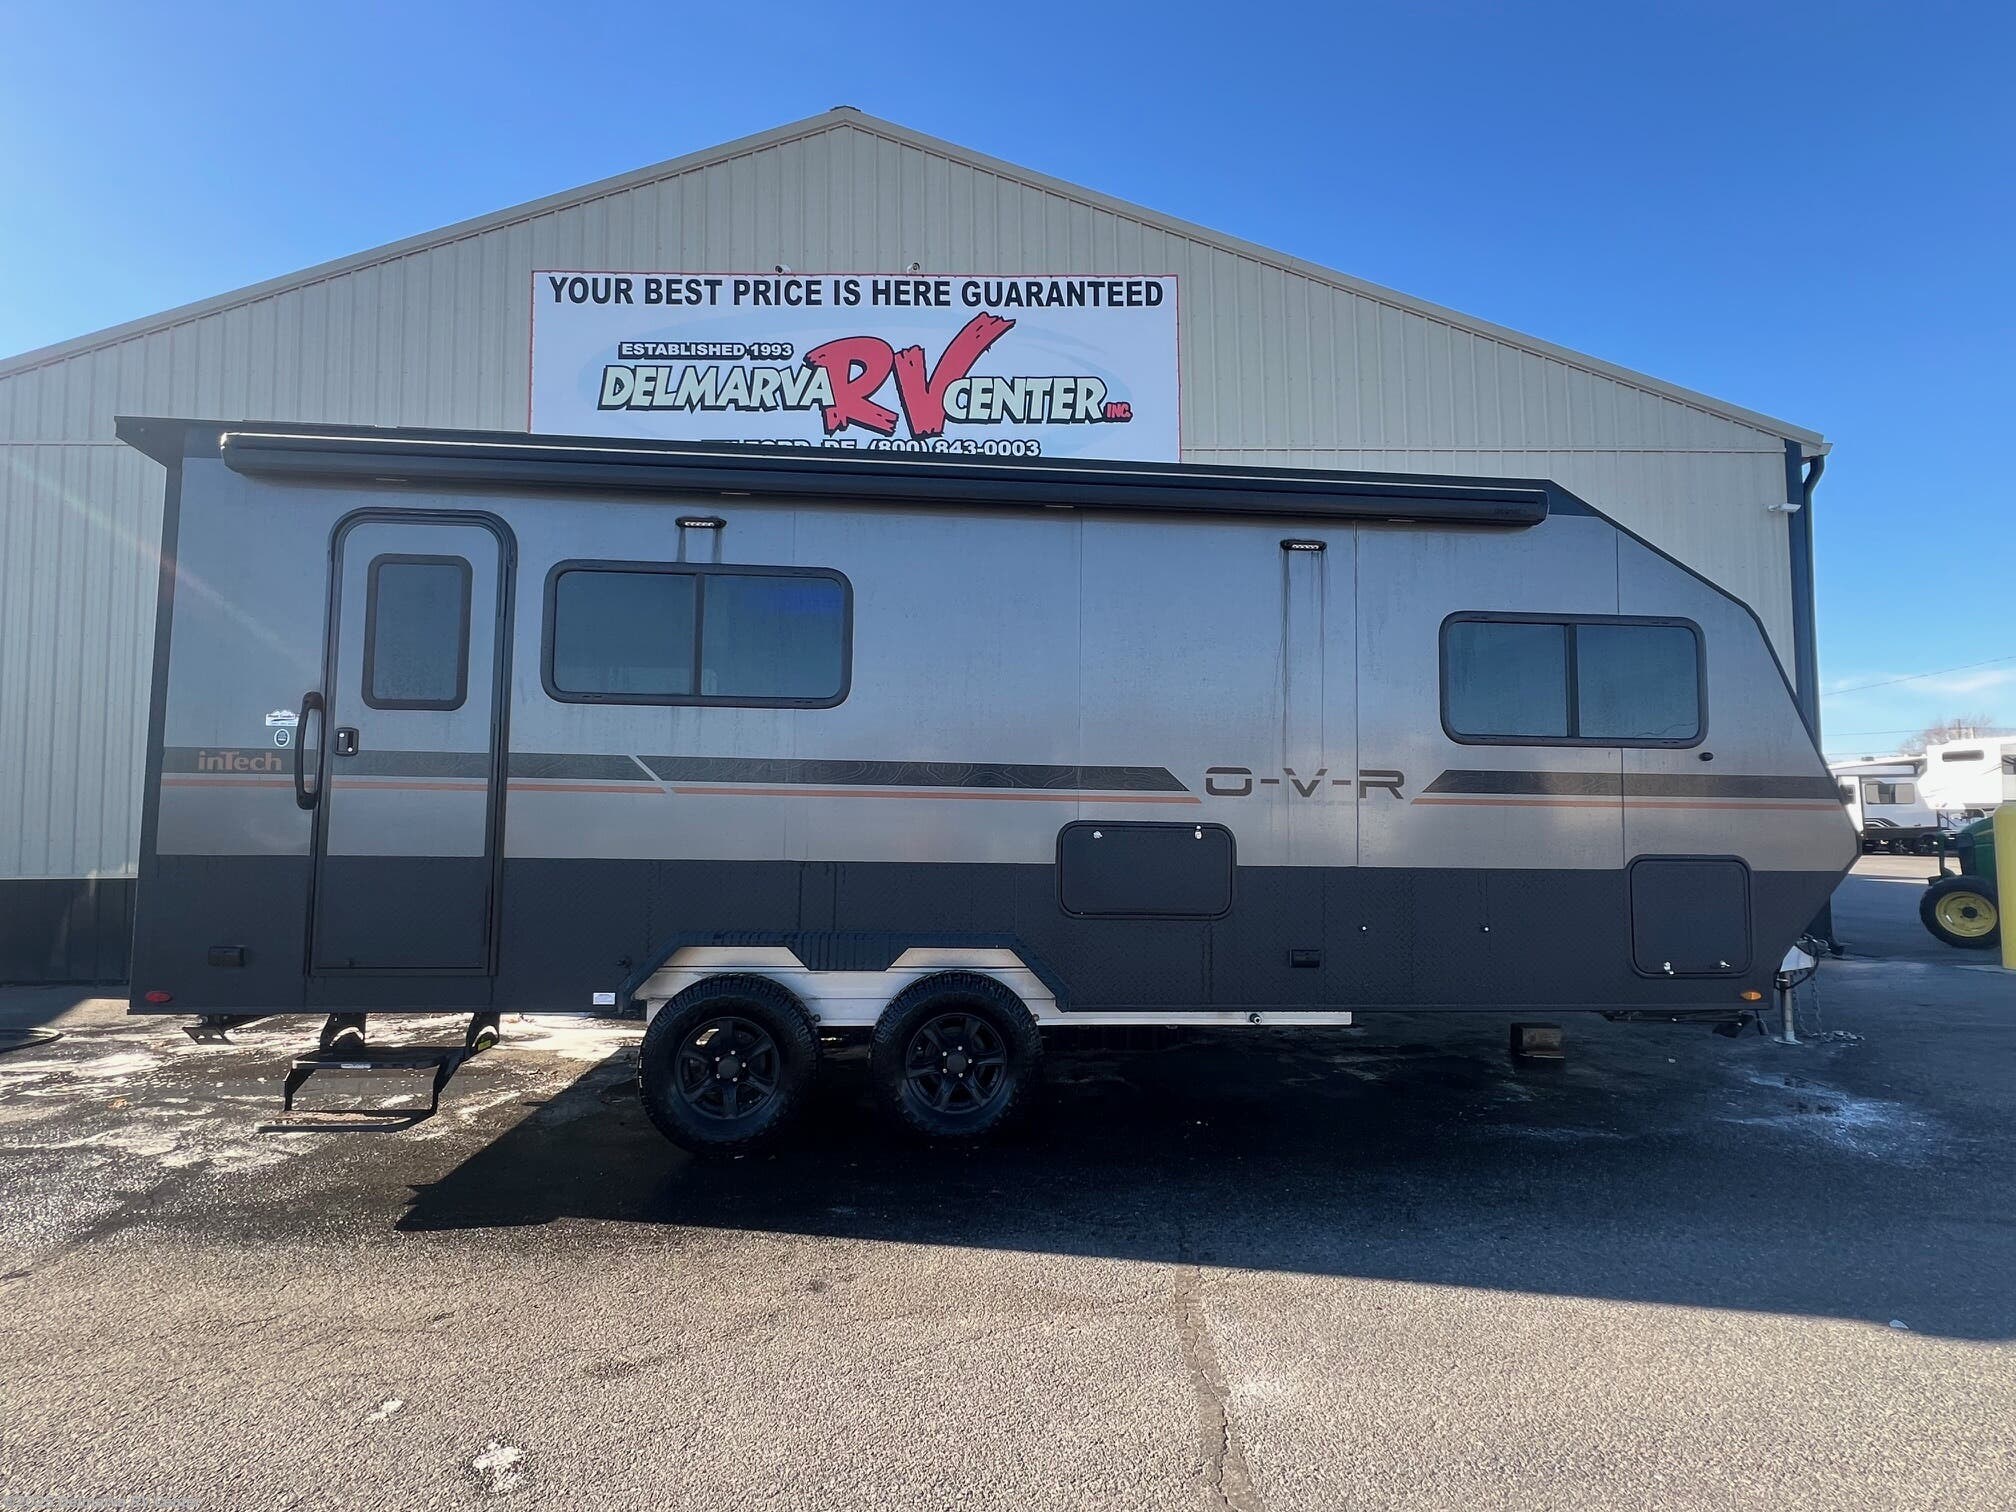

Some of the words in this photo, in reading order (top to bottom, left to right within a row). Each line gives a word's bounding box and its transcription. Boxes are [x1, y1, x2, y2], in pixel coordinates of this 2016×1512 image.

[549, 276, 634, 304] YOUR
[644, 278, 722, 305] BEST
[733, 279, 823, 306] PRICE
[833, 280, 861, 306] IS
[872, 280, 951, 306] HERE
[961, 281, 1163, 307] GUARANTEED
[619, 342, 746, 359] ESTABLISHED
[598, 365, 836, 412] DELMARVA
[803, 312, 1016, 437] RV
[943, 376, 1107, 424] CENTER
[934, 439, 1041, 457] 843-0003
[199, 751, 282, 771] inTech
[1205, 766, 1405, 799] O-V-R
